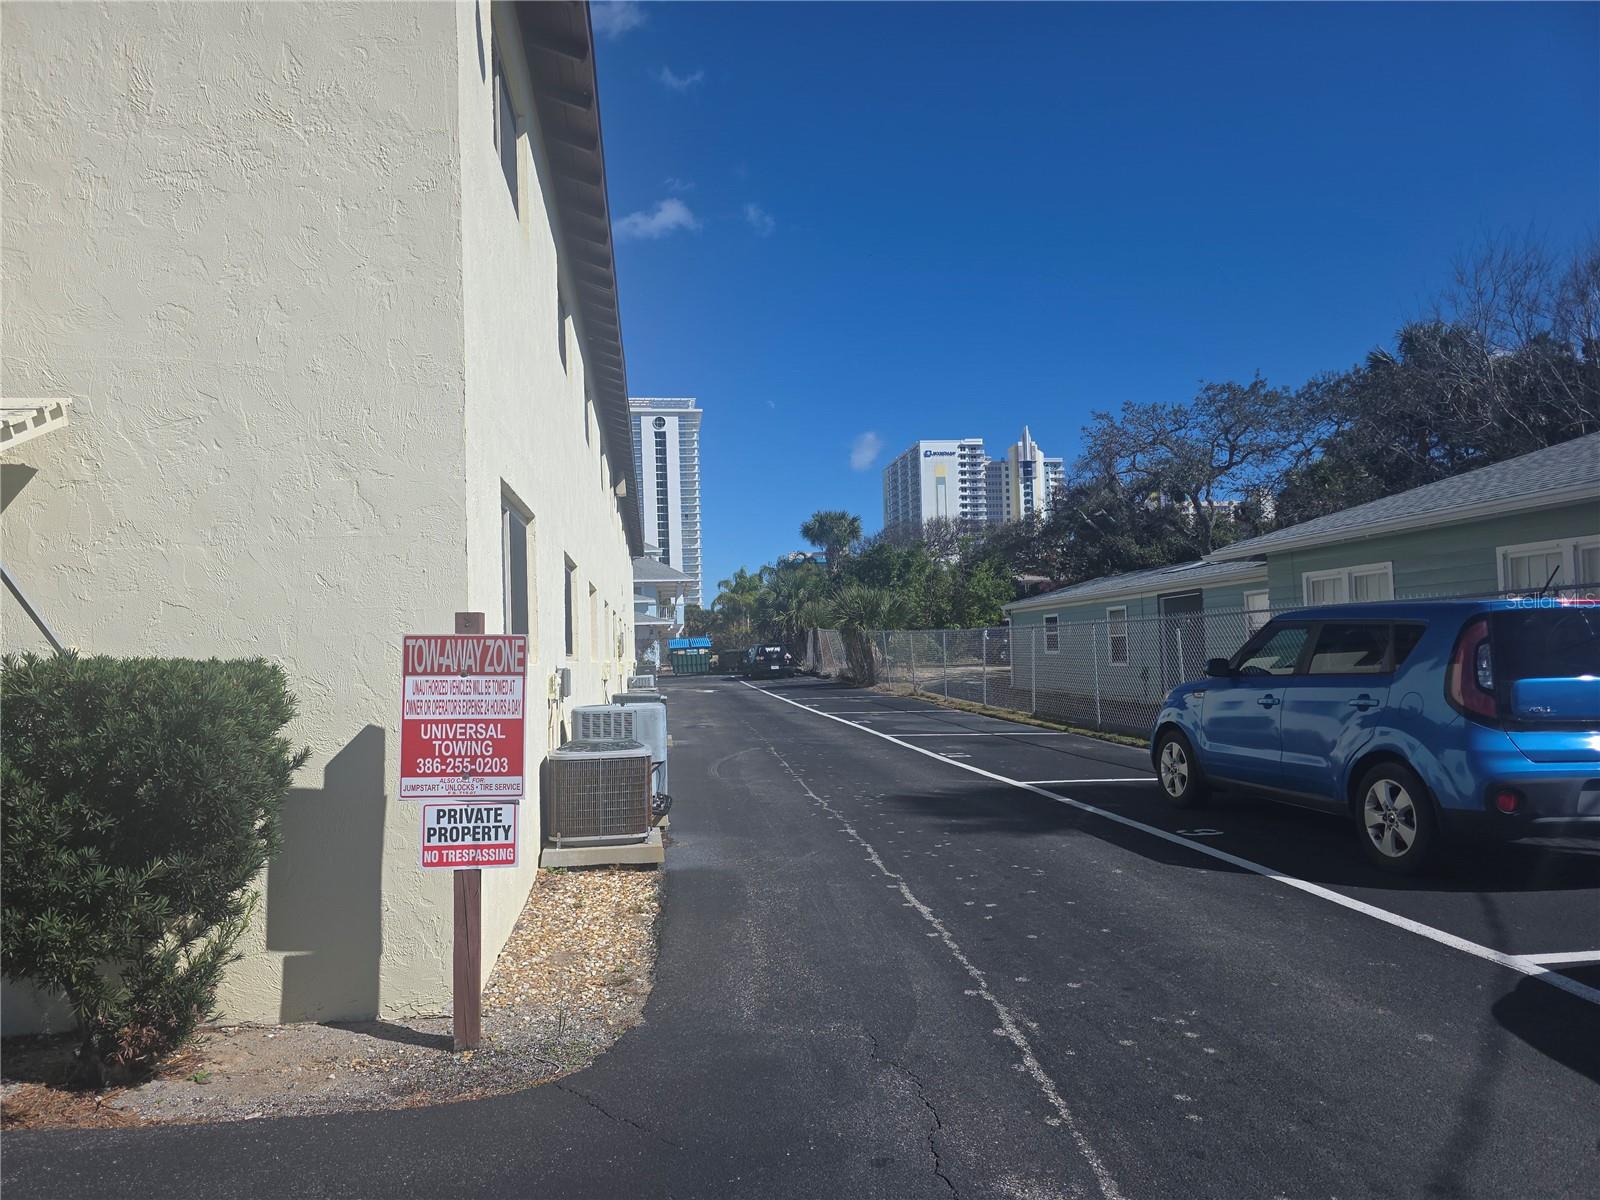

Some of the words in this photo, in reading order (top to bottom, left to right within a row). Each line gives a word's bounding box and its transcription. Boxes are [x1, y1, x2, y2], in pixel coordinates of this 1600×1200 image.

[405, 639, 484, 673] TOW-AWAY
[484, 639, 525, 673] ZONE
[412, 680, 448, 696] UNAUTHORIZED
[449, 680, 472, 696] VEHICLES
[473, 680, 484, 696] WILL
[485, 680, 492, 696] BE
[492, 680, 508, 696] TOWED
[509, 680, 516, 696] AT
[405, 699, 423, 715] OWNER
[424, 699, 431, 715] OR
[462, 699, 485, 715] EXPENSE
[491, 699, 507, 715] HOURS
[512, 699, 521, 715] DAY
[421, 724, 506, 739] UNIVERSAL
[432, 740, 493, 756] TOWING
[416, 758, 508, 773] 386-255-0203
[436, 807, 503, 825] PRIVATE
[426, 825, 512, 843] PROPERTY
[423, 850, 439, 863] NO
[441, 848, 514, 863] TRESPASSING
